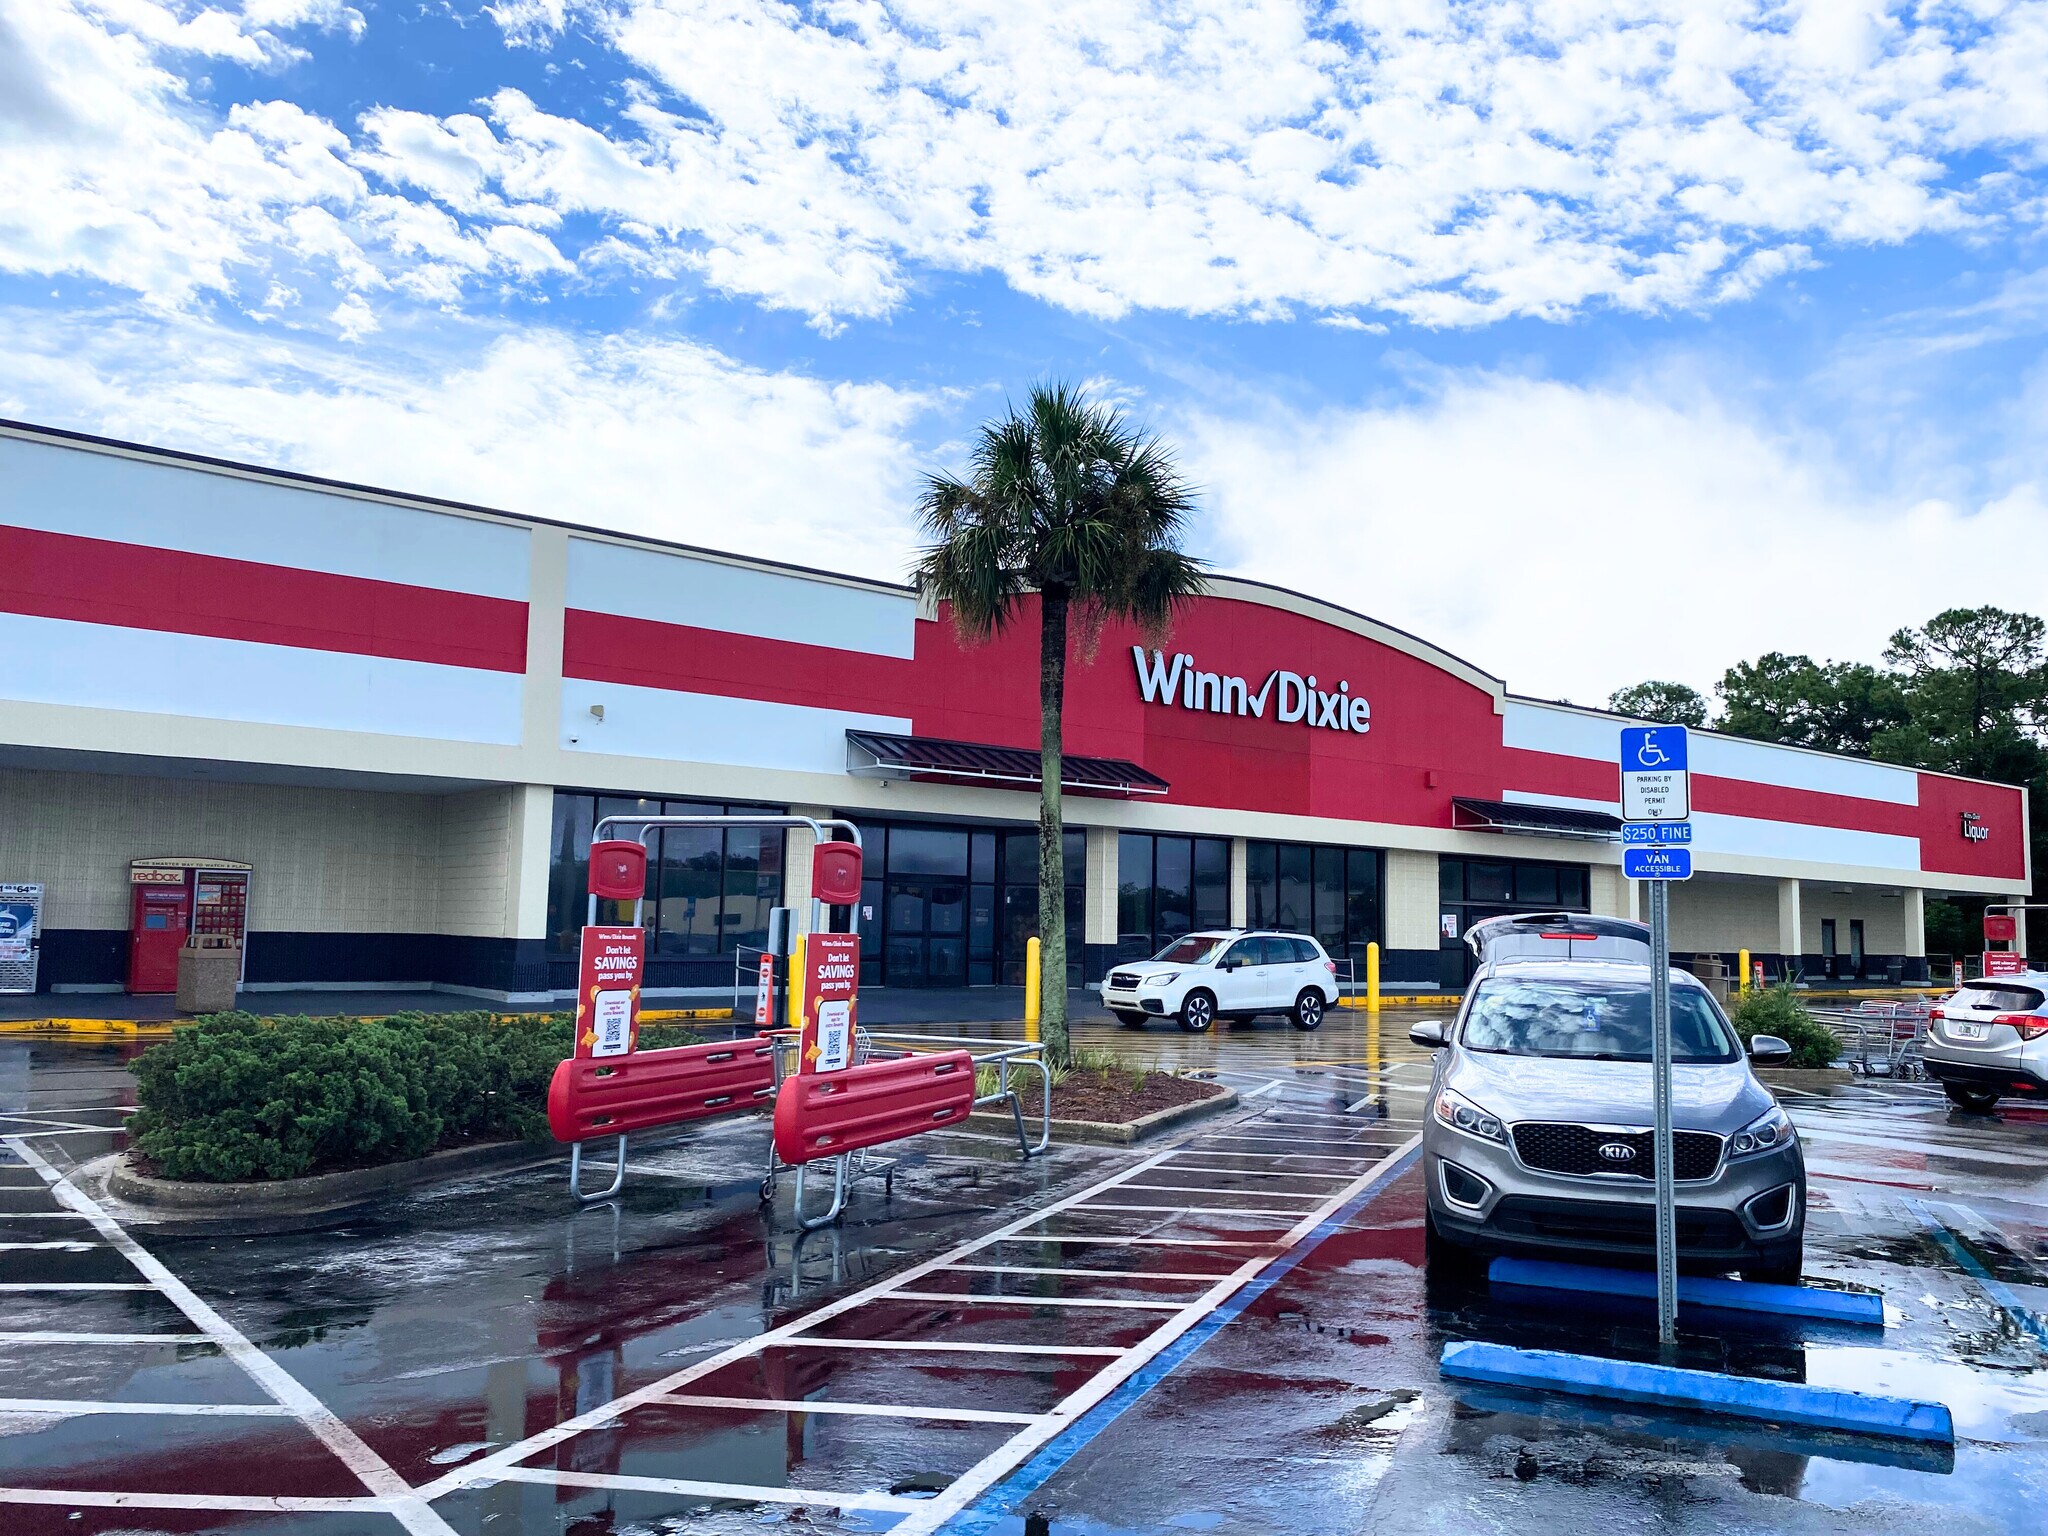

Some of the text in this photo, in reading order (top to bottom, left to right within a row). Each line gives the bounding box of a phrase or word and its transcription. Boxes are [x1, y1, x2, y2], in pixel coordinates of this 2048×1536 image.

[1133, 645, 1370, 733] Winn Dixie
[1640, 786, 1670, 794] DISABLED
[1624, 826, 1690, 841] $250 FINE
[1964, 820, 1989, 843] Liquor
[1646, 854, 1669, 864] VAN
[1634, 865, 1681, 873] ACCESSIBLE
[605, 945, 631, 954] Don't let
[594, 956, 638, 970] SAVINGS
[828, 953, 843, 962] Don't
[598, 970, 633, 982] pass you by.
[817, 964, 855, 979] SAVINGS
[821, 983, 834, 992] pass
[834, 982, 845, 992] you
[1605, 1146, 1630, 1158] KIA
